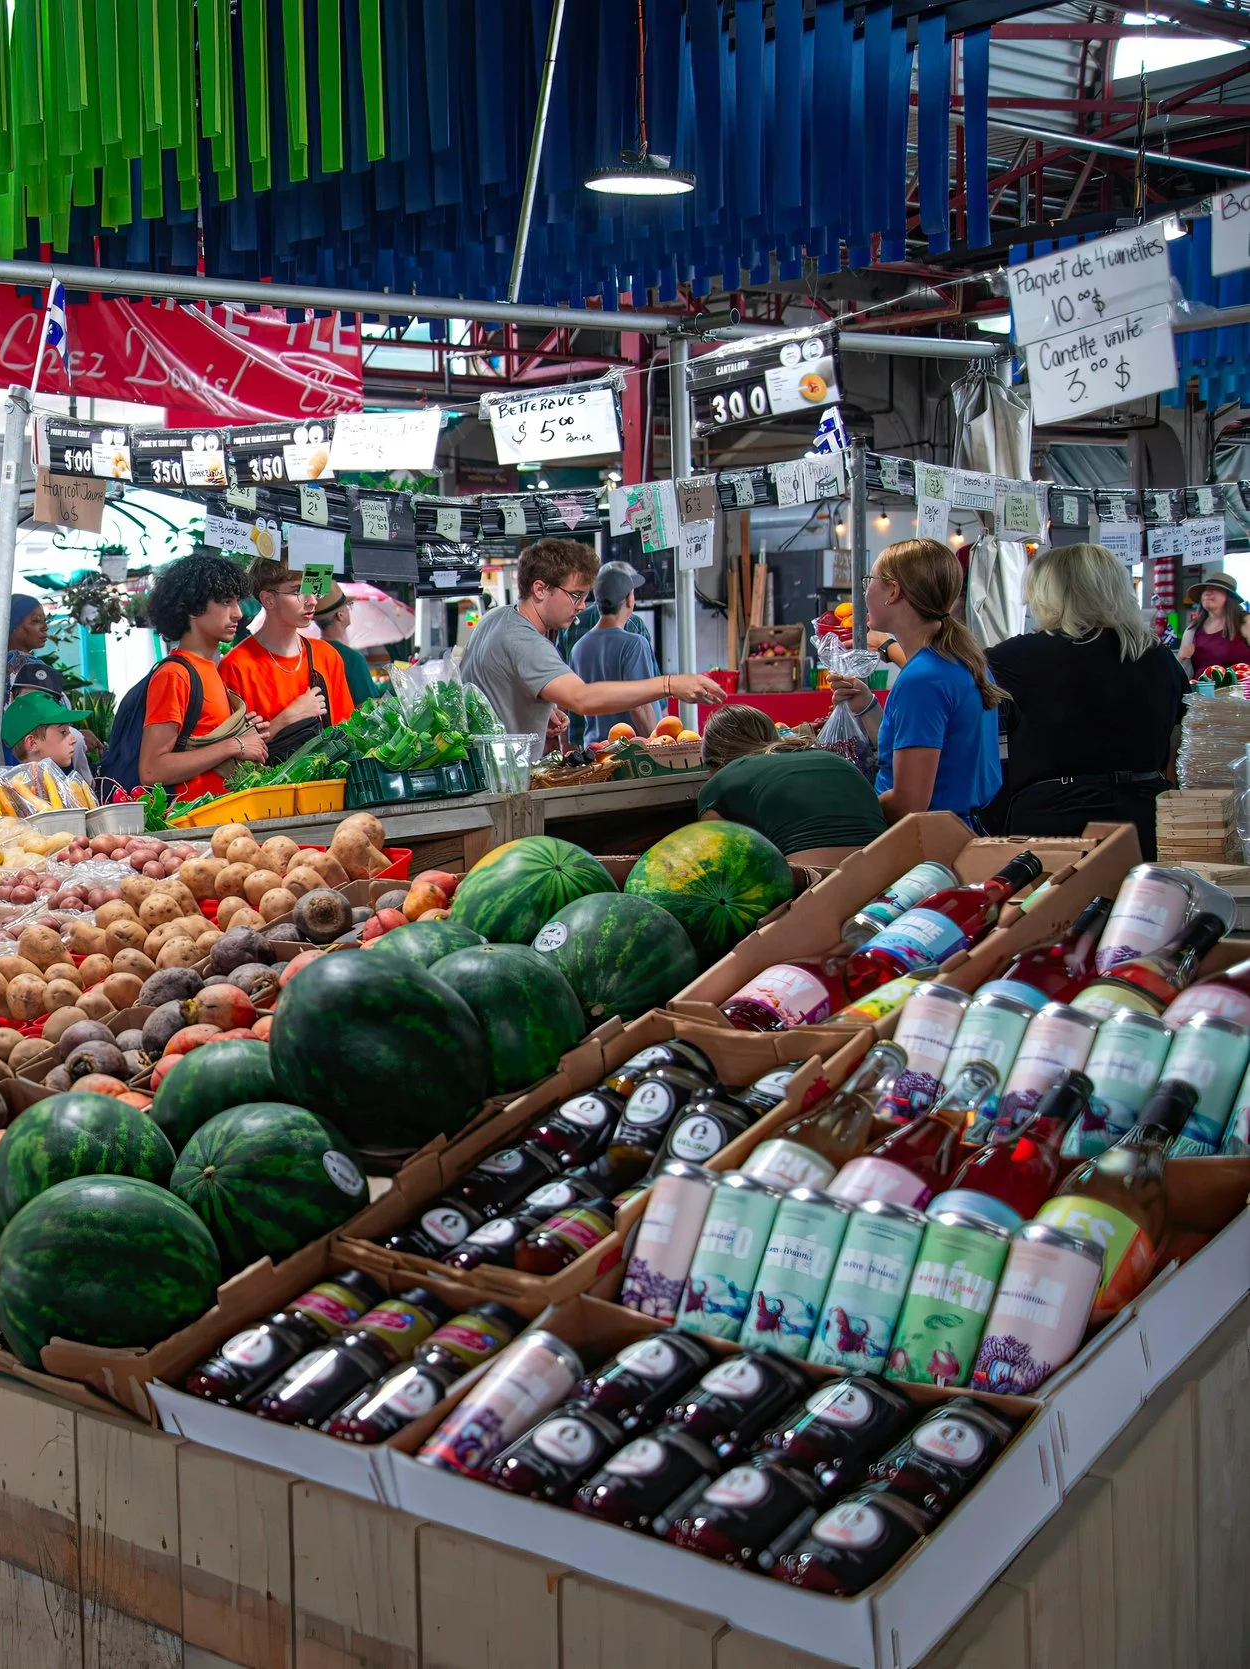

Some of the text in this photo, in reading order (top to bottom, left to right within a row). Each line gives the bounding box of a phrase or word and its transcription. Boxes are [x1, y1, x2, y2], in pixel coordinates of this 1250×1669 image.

[1013, 256, 1068, 296] Paquet
[1071, 254, 1093, 278] de
[715, 360, 750, 376] CANTALOUP
[1114, 354, 1132, 392] $
